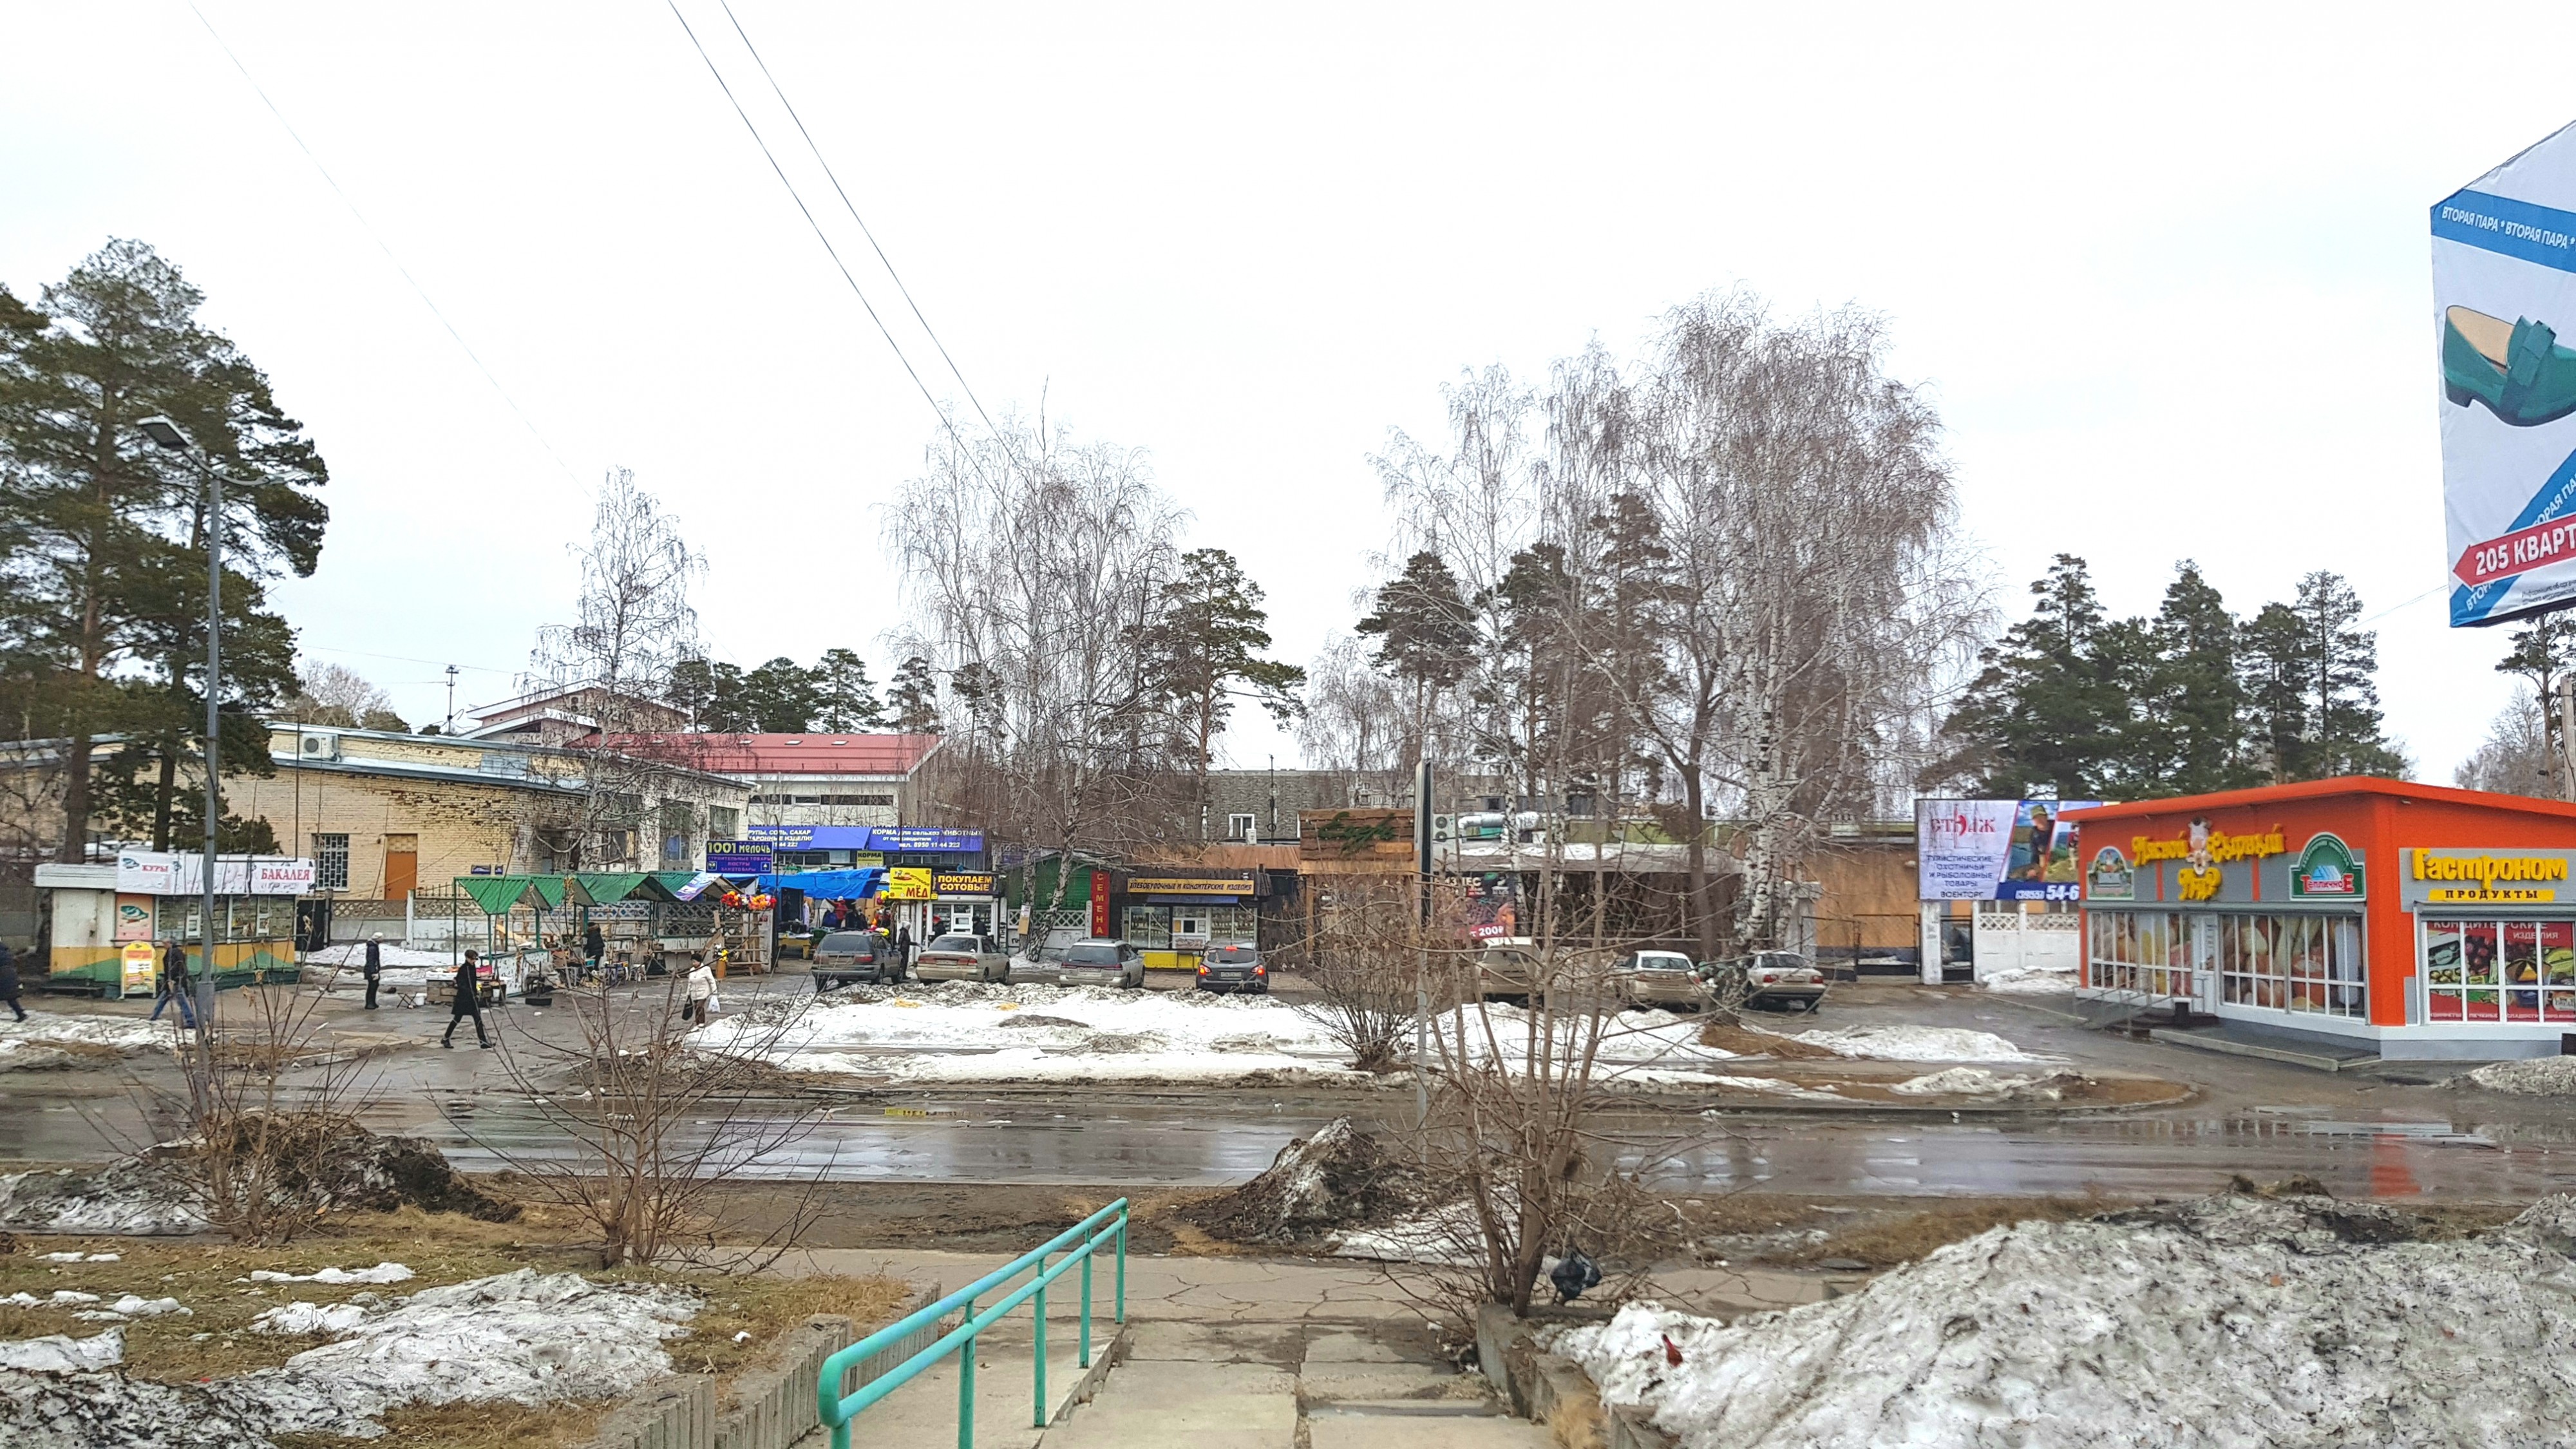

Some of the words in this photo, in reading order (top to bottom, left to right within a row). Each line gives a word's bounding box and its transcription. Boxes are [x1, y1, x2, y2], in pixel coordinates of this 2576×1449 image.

[2441, 206, 2476, 225] ВТОРАЯ
[2474, 214, 2499, 232] ПАРА
[2505, 221, 2542, 243] ВТОРАЯ
[2542, 230, 2568, 249] ПАРА
[2533, 493, 2563, 525] ОРАЯ
[2561, 473, 2576, 499] ПА
[2476, 544, 2509, 576] 205
[2514, 522, 2576, 565] КВАРТ
[2466, 583, 2492, 612] ВТОР
[707, 842, 737, 854] 1001
[261, 868, 310, 881] БАКАЛЕЯ
[2412, 848, 2568, 890] Гастроном
[938, 875, 992, 884] ПОКУПАЕМ
[906, 884, 928, 898] МЁД
[940, 883, 990, 891] СОТОВЫЕ
[2445, 890, 2538, 900] ПРОДУКТЫ
[1095, 873, 1104, 934] СЕМЕНА
[2512, 931, 2559, 940] ИЗДЕЛИЯ
